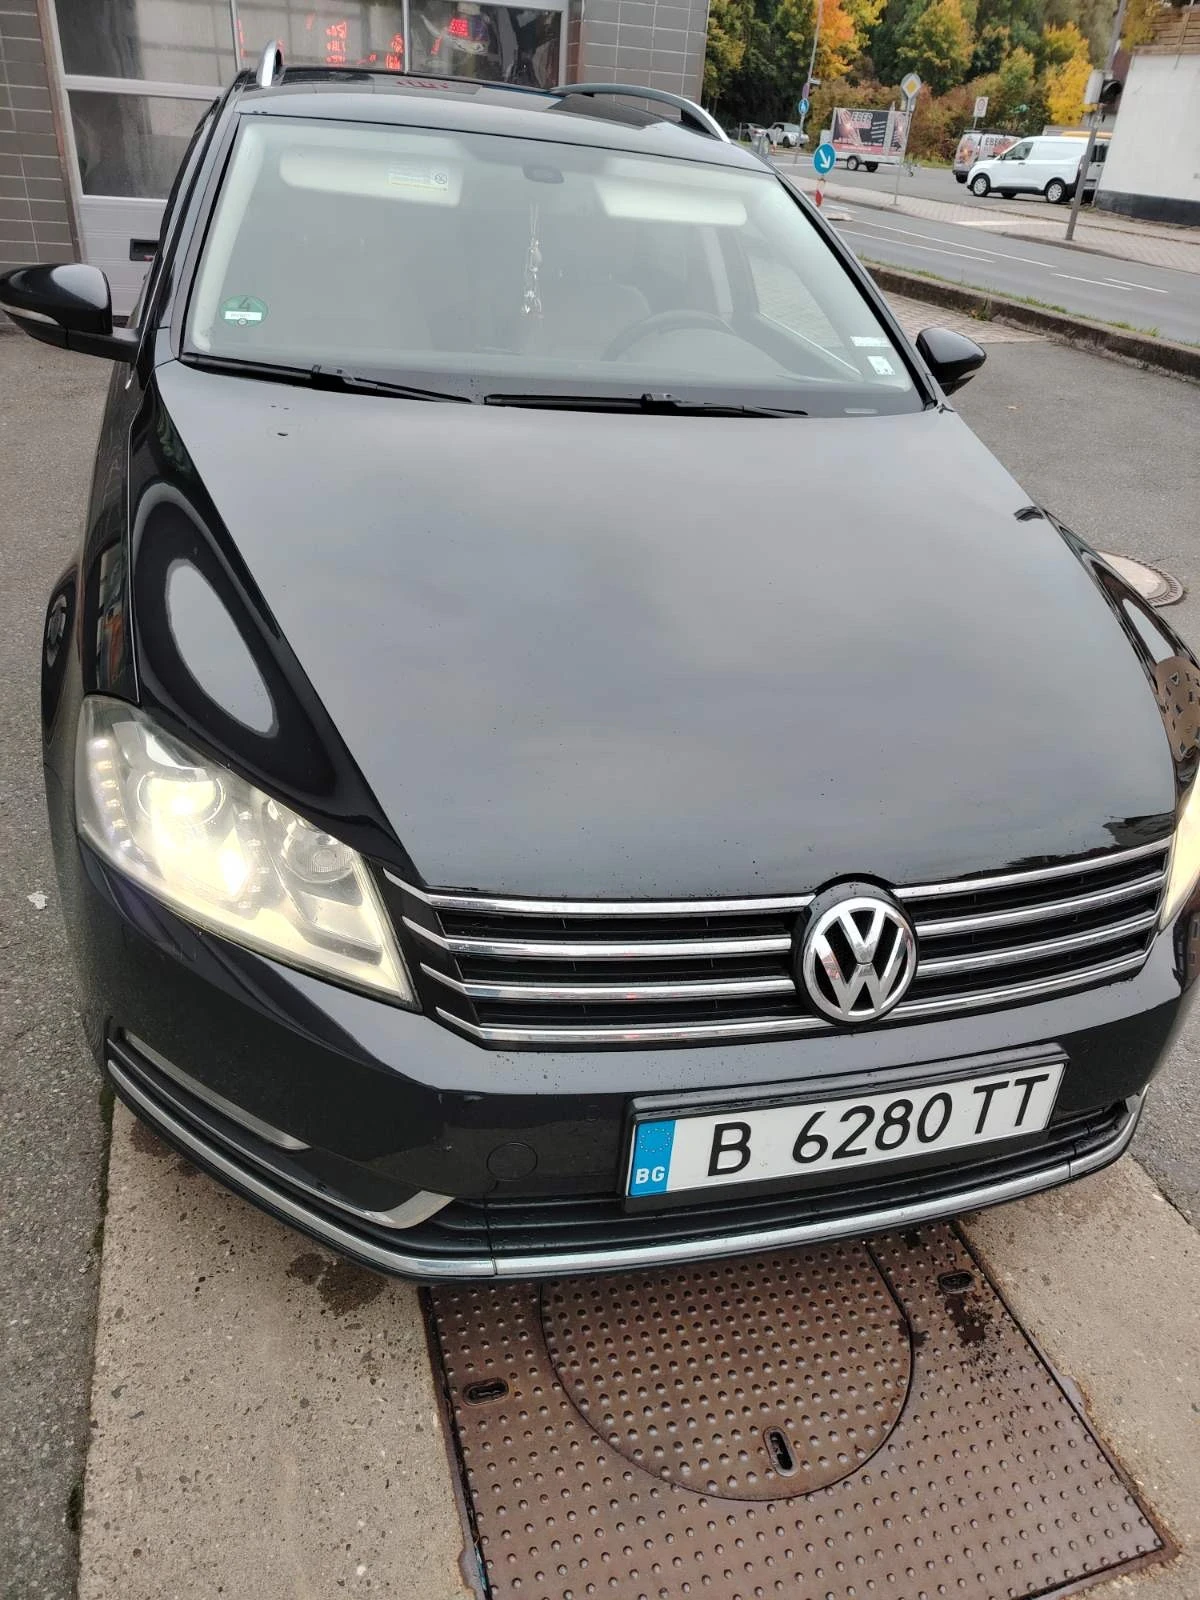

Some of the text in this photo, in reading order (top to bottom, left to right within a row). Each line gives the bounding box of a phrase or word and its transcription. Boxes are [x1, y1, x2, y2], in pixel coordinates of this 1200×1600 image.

[239, 295, 250, 311] 4
[803, 896, 917, 1022] VW
[708, 1073, 1050, 1177] B 6280 TT
[635, 1166, 665, 1185] BG
